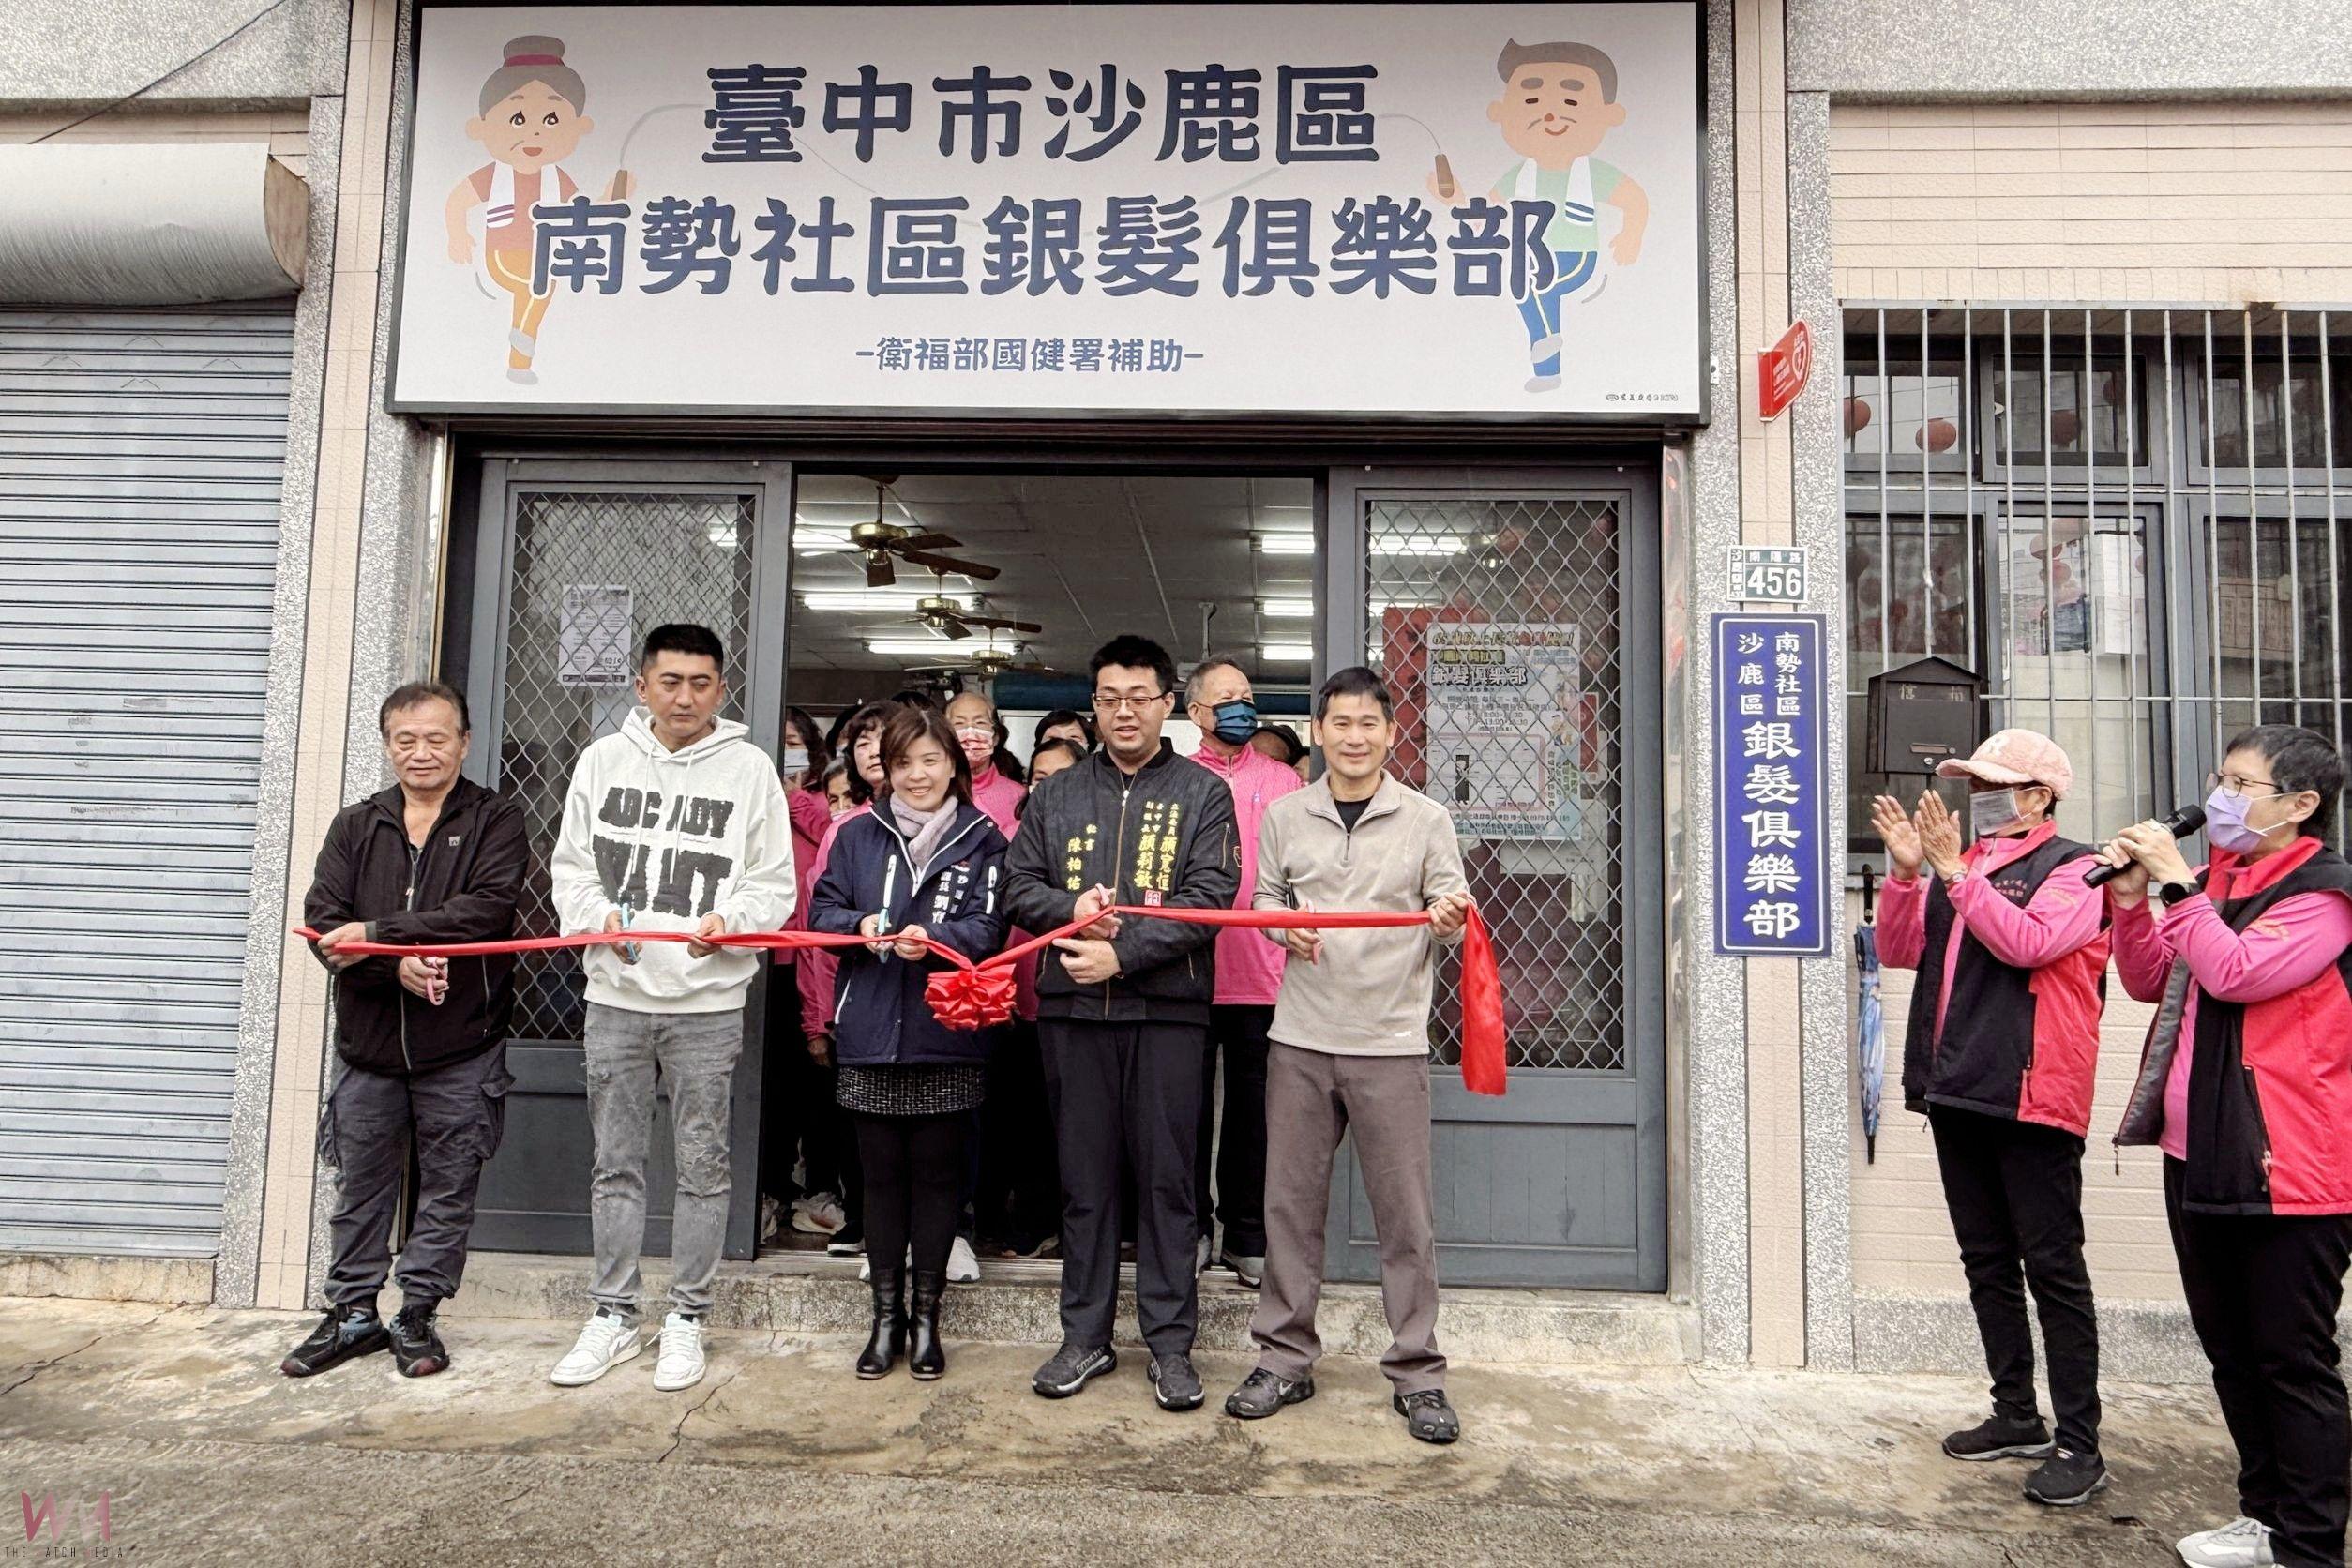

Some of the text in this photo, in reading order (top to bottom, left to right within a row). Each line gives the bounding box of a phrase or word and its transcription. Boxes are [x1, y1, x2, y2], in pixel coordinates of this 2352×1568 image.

[702, 63, 1380, 165] 臺中市沙鹿區
[530, 195, 1557, 300] 南勢社區銀髮俱樂部
[1747, 566, 1802, 596] 456
[1738, 632, 1765, 716] 沙鹿區
[1775, 631, 1802, 716] 南勢社區
[1741, 720, 1802, 939] 銀髮俱樂部
